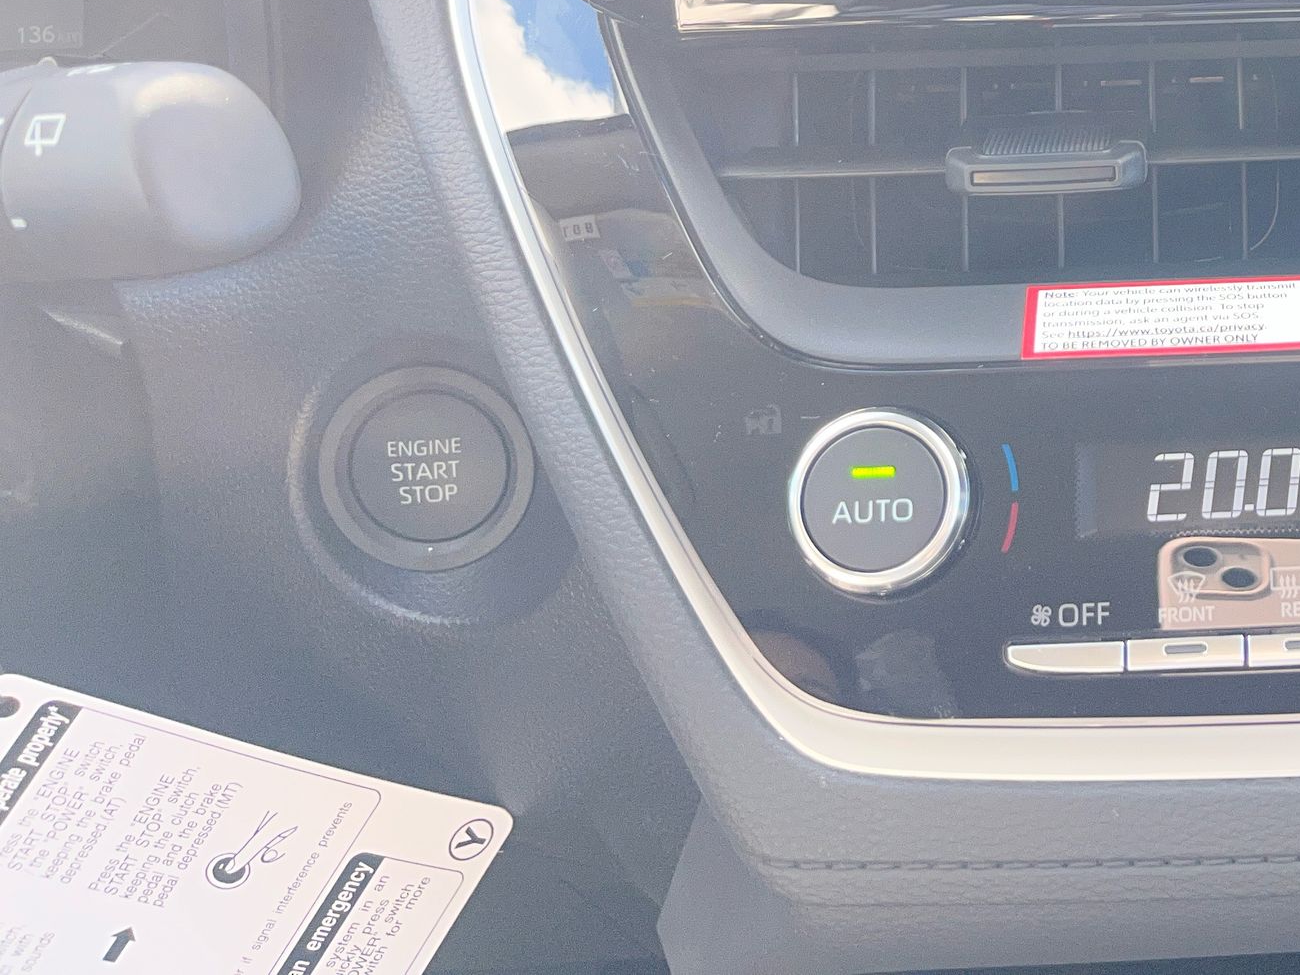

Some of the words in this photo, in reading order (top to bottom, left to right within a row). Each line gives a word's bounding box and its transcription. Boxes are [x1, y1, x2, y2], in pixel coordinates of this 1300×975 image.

[18, 26, 55, 44] 136
[1143, 295, 1194, 305] pressing
[1159, 287, 1181, 295] can
[1184, 284, 1242, 293] wirelessly
[1042, 331, 1064, 339] See
[1043, 319, 1125, 328] transmission,
[1173, 315, 1208, 323] agent
[1041, 342, 1058, 350] TO
[1062, 341, 1078, 349] BE
[1082, 338, 1147, 349] REMOVED
[1151, 337, 1166, 347] BY
[1170, 335, 1220, 345] OWNER
[1224, 334, 1258, 343] ONLY
[387, 437, 461, 457] ENGINE
[391, 460, 460, 481] START
[400, 484, 458, 504] STOP
[832, 498, 914, 524] AUTO
[1059, 601, 1111, 627] OFF
[1158, 605, 1216, 623] FRONT
[8, 829, 43, 872] START
[74, 741, 105, 778] switch
[43, 833, 83, 880] keeping
[76, 808, 97, 830] the
[91, 771, 122, 805] brake
[119, 734, 147, 767] pedal
[0, 832, 22, 860] ress
[19, 808, 40, 828] the
[119, 854, 161, 900] keeping
[154, 830, 174, 851] the
[172, 792, 199, 826] clutch
[137, 872, 165, 905] pedal
[162, 844, 183, 867] and
[179, 820, 198, 840] the
[192, 783, 222, 816] brake
[454, 826, 486, 850] Y
[29, 848, 50, 869] the
[88, 858, 120, 892] Press
[116, 834, 136, 853] the
[103, 853, 139, 896] START
[252, 918, 277, 951] signal
[275, 852, 320, 914] interference
[319, 801, 353, 849] prevents
[153, 875, 180, 908] pedal
[385, 884, 414, 924] switch
[306, 862, 374, 952] emergency
[326, 922, 360, 968] system
[361, 900, 374, 913] in
[374, 874, 391, 892] an
[362, 899, 390, 936] press
[365, 946, 388, 975] witch
[386, 920, 403, 937] for
[405, 876, 431, 910] more
